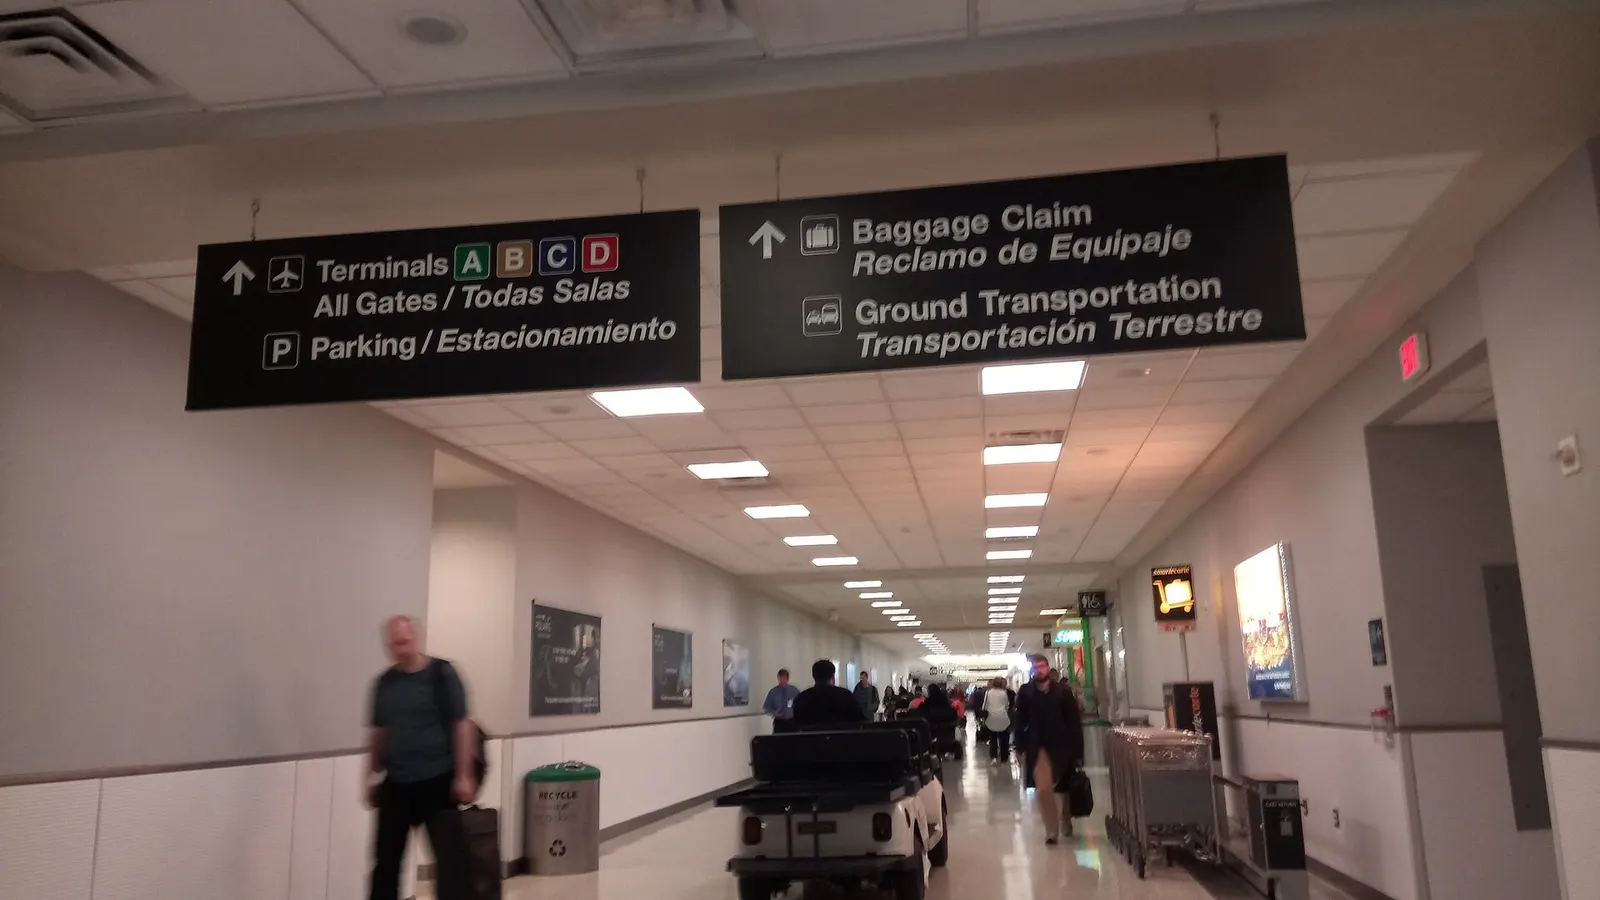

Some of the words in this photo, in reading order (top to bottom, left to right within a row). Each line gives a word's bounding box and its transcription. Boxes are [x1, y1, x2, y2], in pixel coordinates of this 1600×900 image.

[853, 213, 990, 247] Baggage
[1001, 201, 1092, 232] Claim
[316, 253, 449, 283] Terminals
[461, 250, 483, 274] A
[504, 247, 525, 271] B
[546, 243, 568, 269] C
[590, 241, 610, 266] D
[853, 246, 988, 277] Reclamo
[998, 237, 1039, 265] de
[1049, 224, 1193, 264] Equipaje
[313, 292, 349, 318] All
[356, 291, 438, 315] Gates
[461, 282, 545, 309] Todas
[553, 276, 631, 303] Salas
[855, 291, 968, 326] Ground
[979, 274, 1222, 317] Transportation
[272, 338, 291, 364] P
[311, 333, 417, 360] Parking
[436, 316, 677, 353] Estacionamiento
[856, 317, 1097, 358] Transportación
[1109, 306, 1264, 340] Terrestre
[538, 791, 578, 801] RECYCLE
